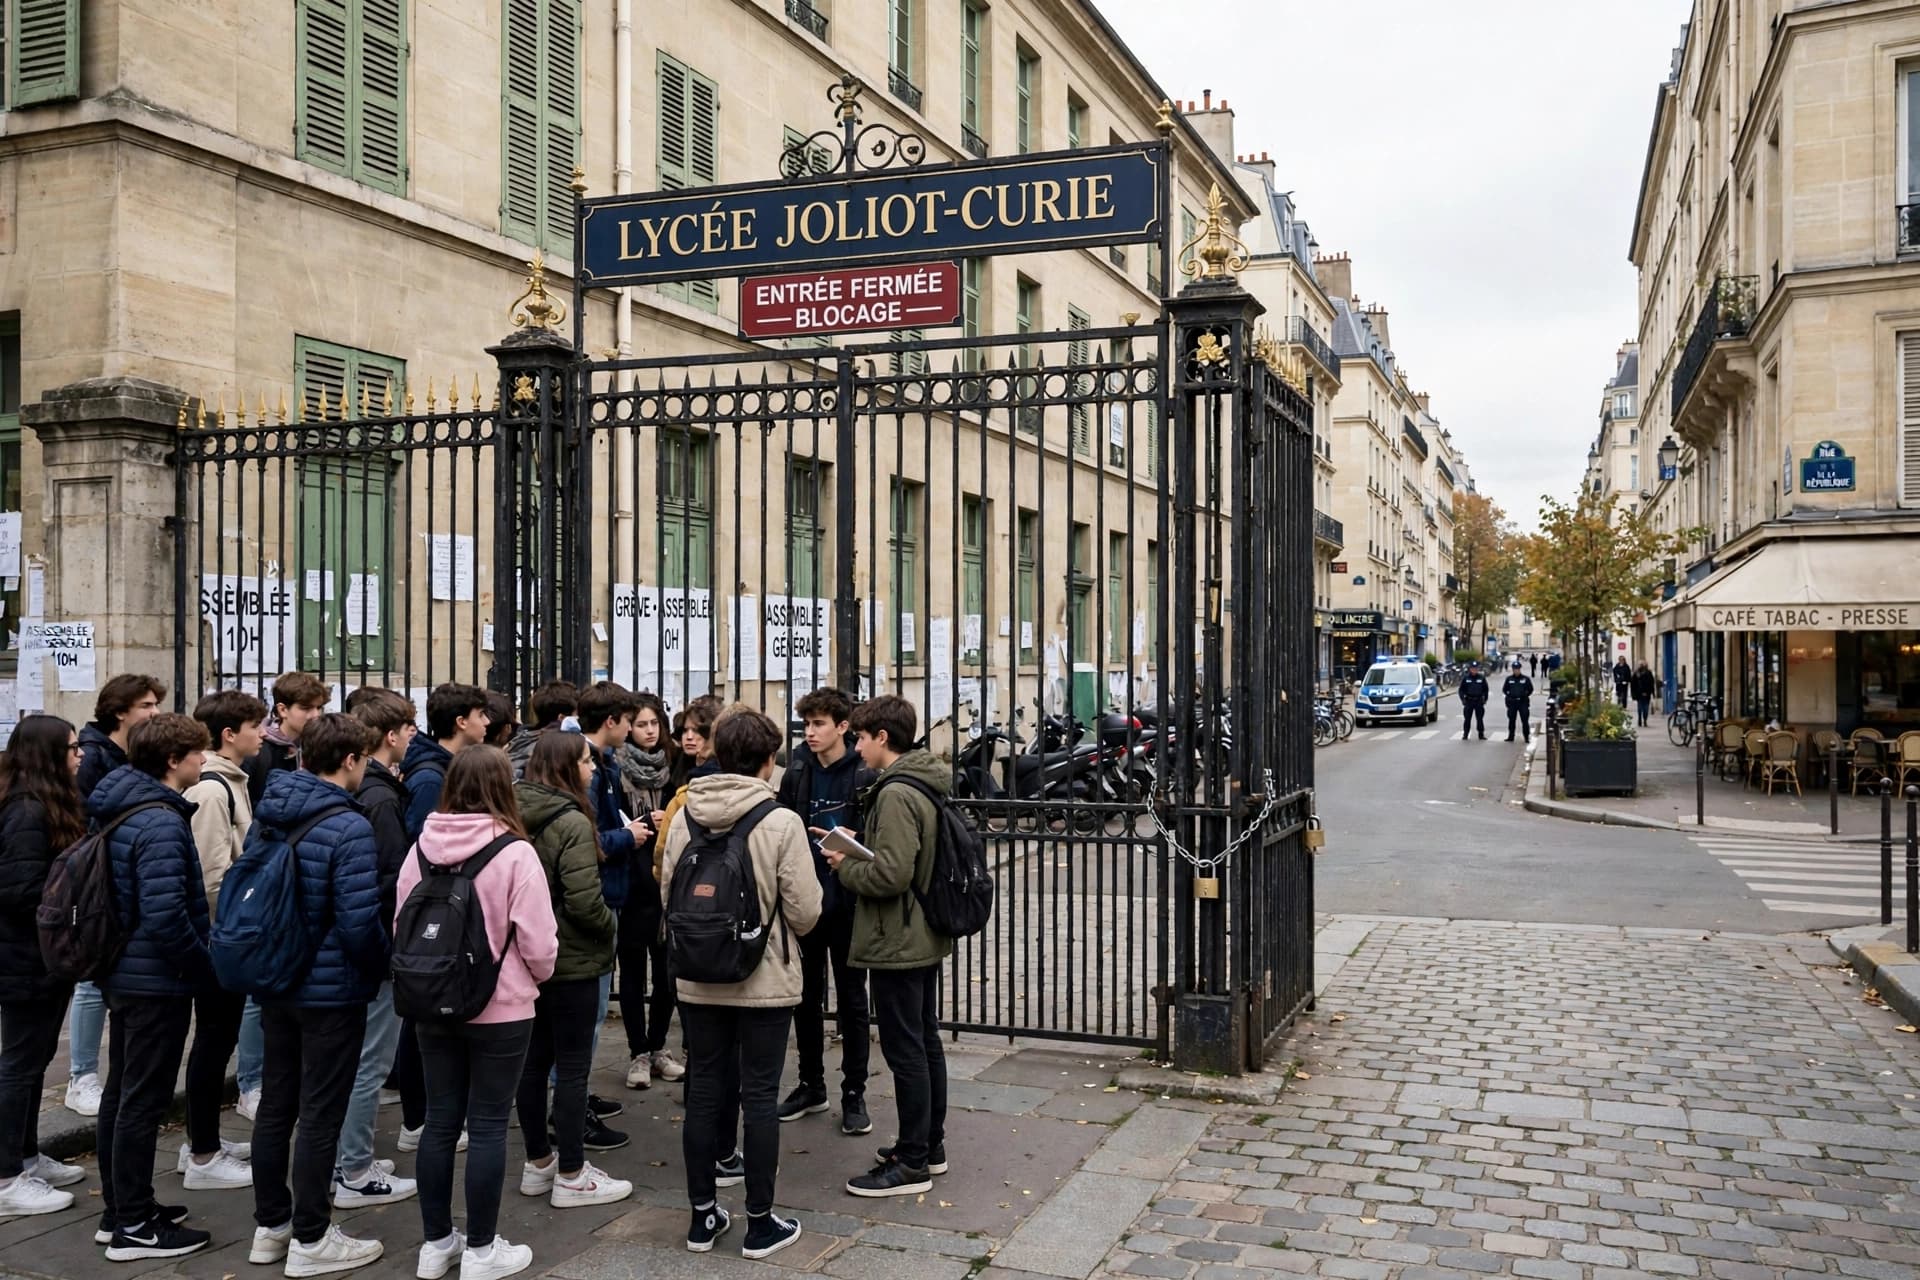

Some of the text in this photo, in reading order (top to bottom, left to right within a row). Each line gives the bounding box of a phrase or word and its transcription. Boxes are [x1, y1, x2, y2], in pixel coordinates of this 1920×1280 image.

[618, 174, 1115, 260] LYCÉE JOLIOT-CURIE
[756, 268, 943, 306] ENTRÉE FERMÉE
[796, 302, 902, 328] BLOCAGE
[1713, 607, 1756, 626] CAFÉ
[1764, 610, 1820, 626] TABAC
[1841, 608, 1909, 625] PRESSE
